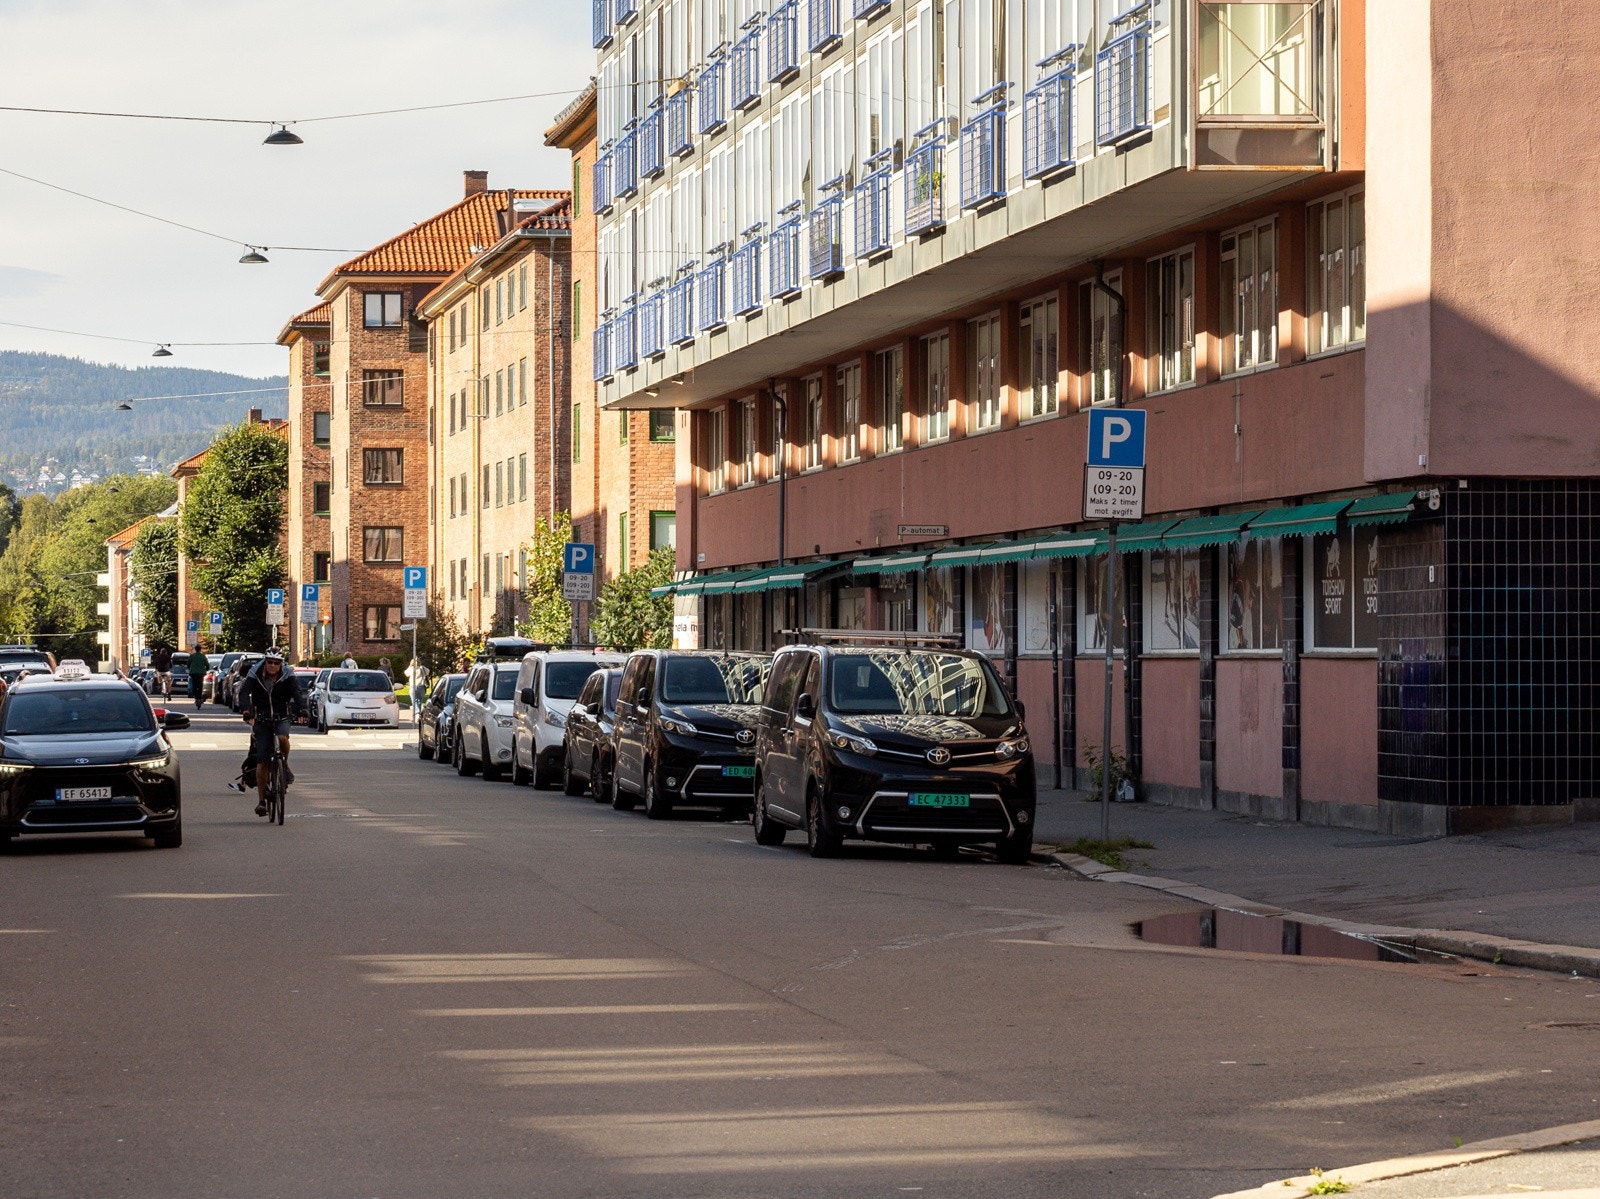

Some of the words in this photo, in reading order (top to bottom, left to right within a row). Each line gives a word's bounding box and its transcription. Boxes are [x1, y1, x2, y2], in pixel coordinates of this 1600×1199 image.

[1102, 416, 1132, 459] P
[1090, 497, 1108, 505] Maks
[1120, 498, 1138, 506] timer
[1112, 508, 1133, 517] avgift
[571, 547, 588, 570] P
[409, 569, 422, 587] P
[305, 586, 315, 599] P
[1321, 579, 1346, 596] TORSHOV
[1362, 577, 1378, 595] TORS
[271, 590, 280, 603] P
[1324, 597, 1342, 615] SPORT
[212, 613, 220, 623] P
[188, 621, 196, 630] P
[728, 767, 739, 776] ED
[64, 789, 75, 799] EF
[80, 788, 108, 798] 65412
[917, 794, 930, 805] EC
[934, 795, 966, 805] 47333
